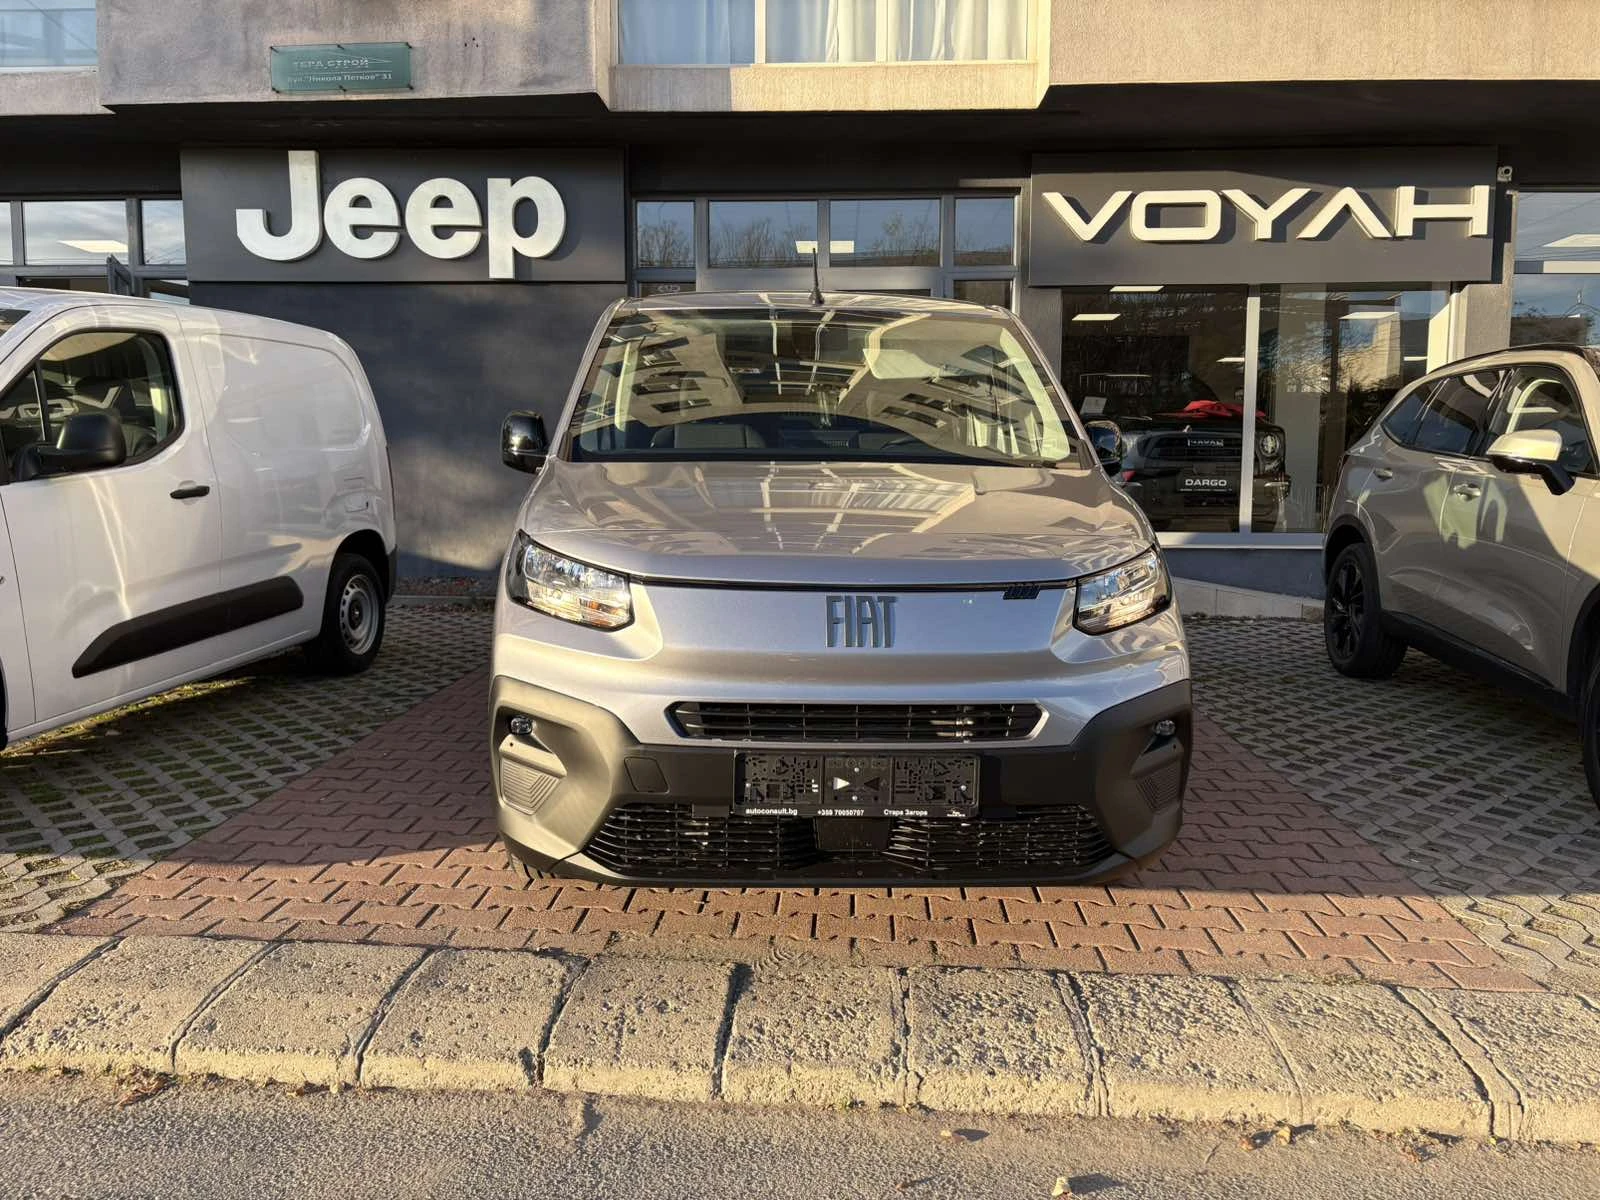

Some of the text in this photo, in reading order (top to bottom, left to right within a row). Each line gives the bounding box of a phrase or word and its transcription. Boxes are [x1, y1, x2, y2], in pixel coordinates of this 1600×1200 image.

[236, 150, 567, 280] Jeep
[1042, 185, 1490, 242] VOYAH
[1185, 478, 1228, 487] DARGO
[826, 595, 898, 649] FIAT
[883, 808, 928, 816] Стара Загора
